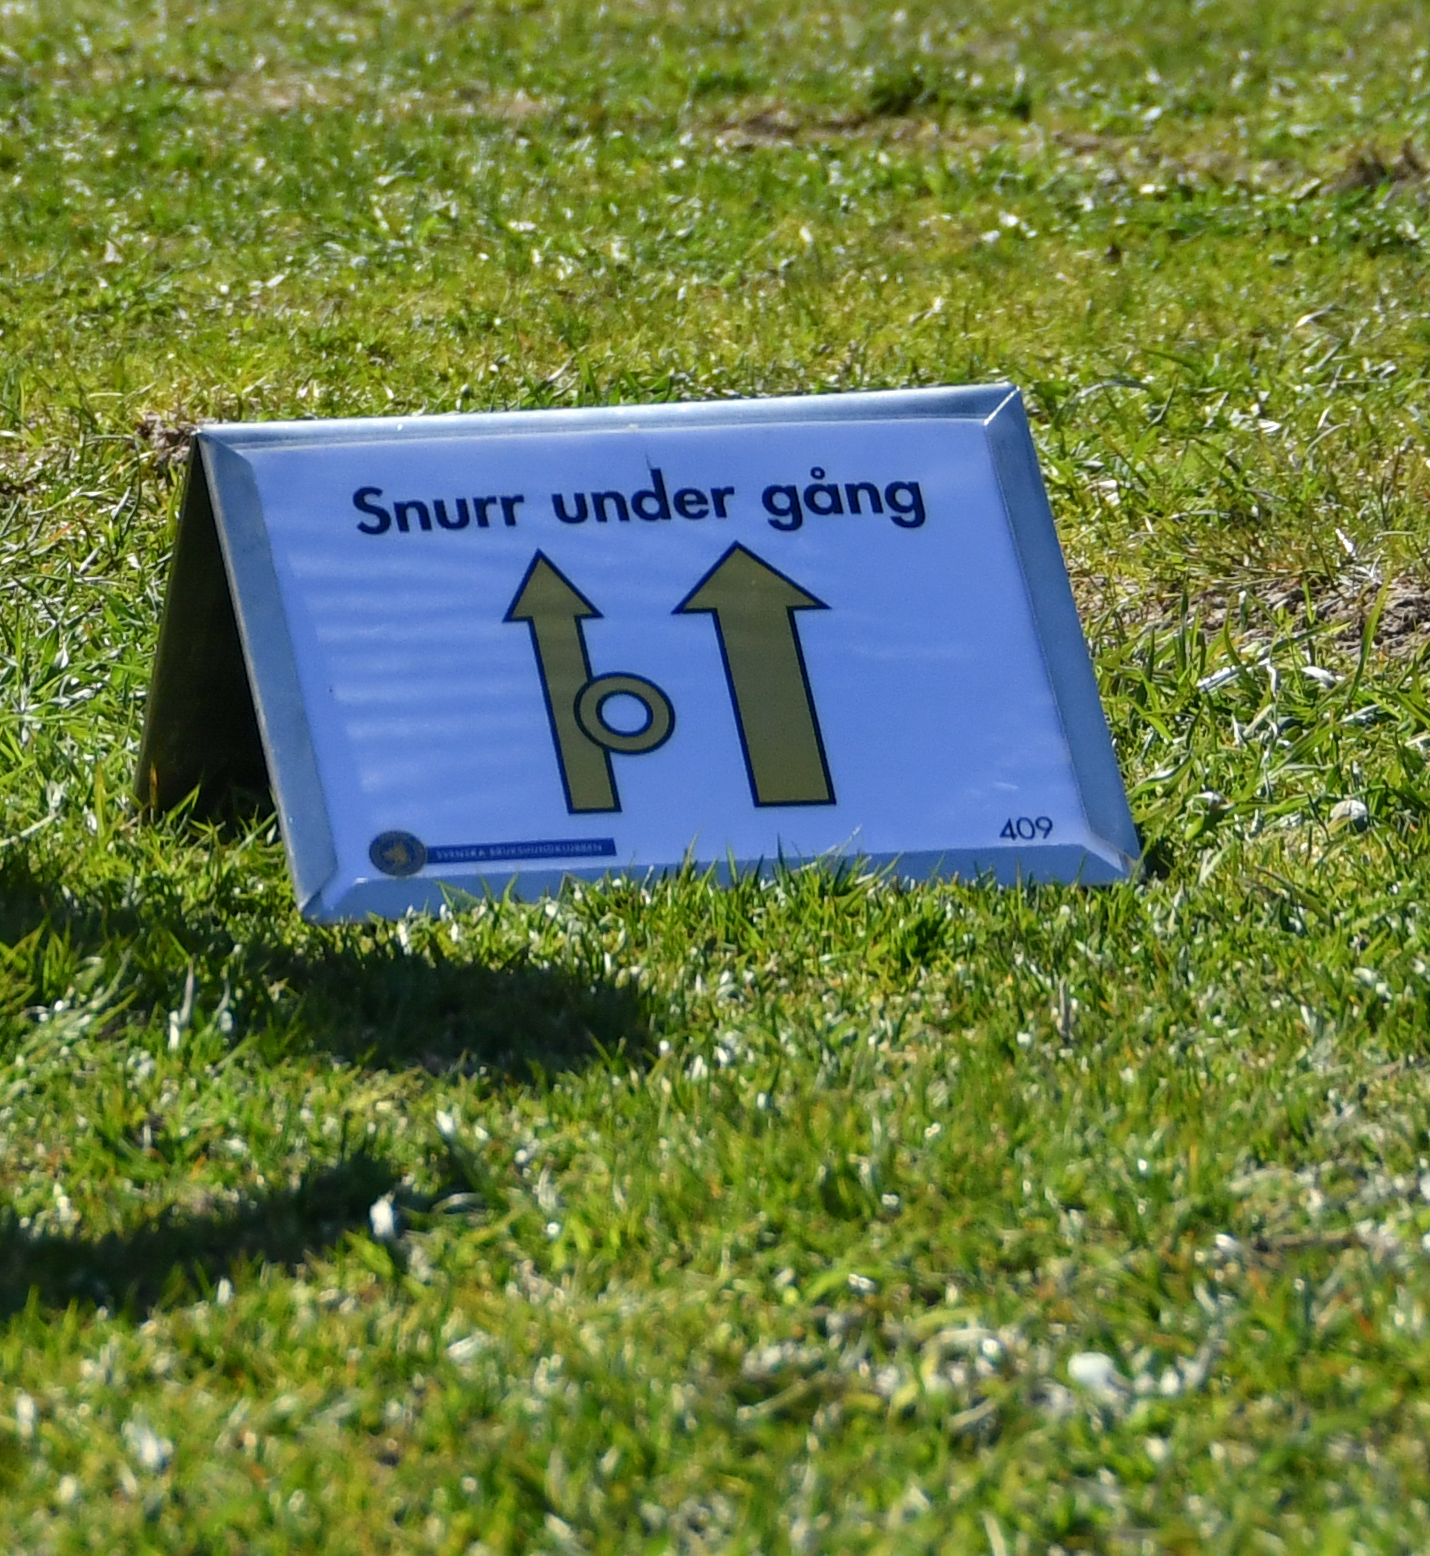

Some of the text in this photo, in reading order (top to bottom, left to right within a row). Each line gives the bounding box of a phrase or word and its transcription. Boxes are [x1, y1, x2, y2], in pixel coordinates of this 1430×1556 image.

[352, 466, 926, 535] Snurr under gång
[999, 816, 1053, 841] 409
